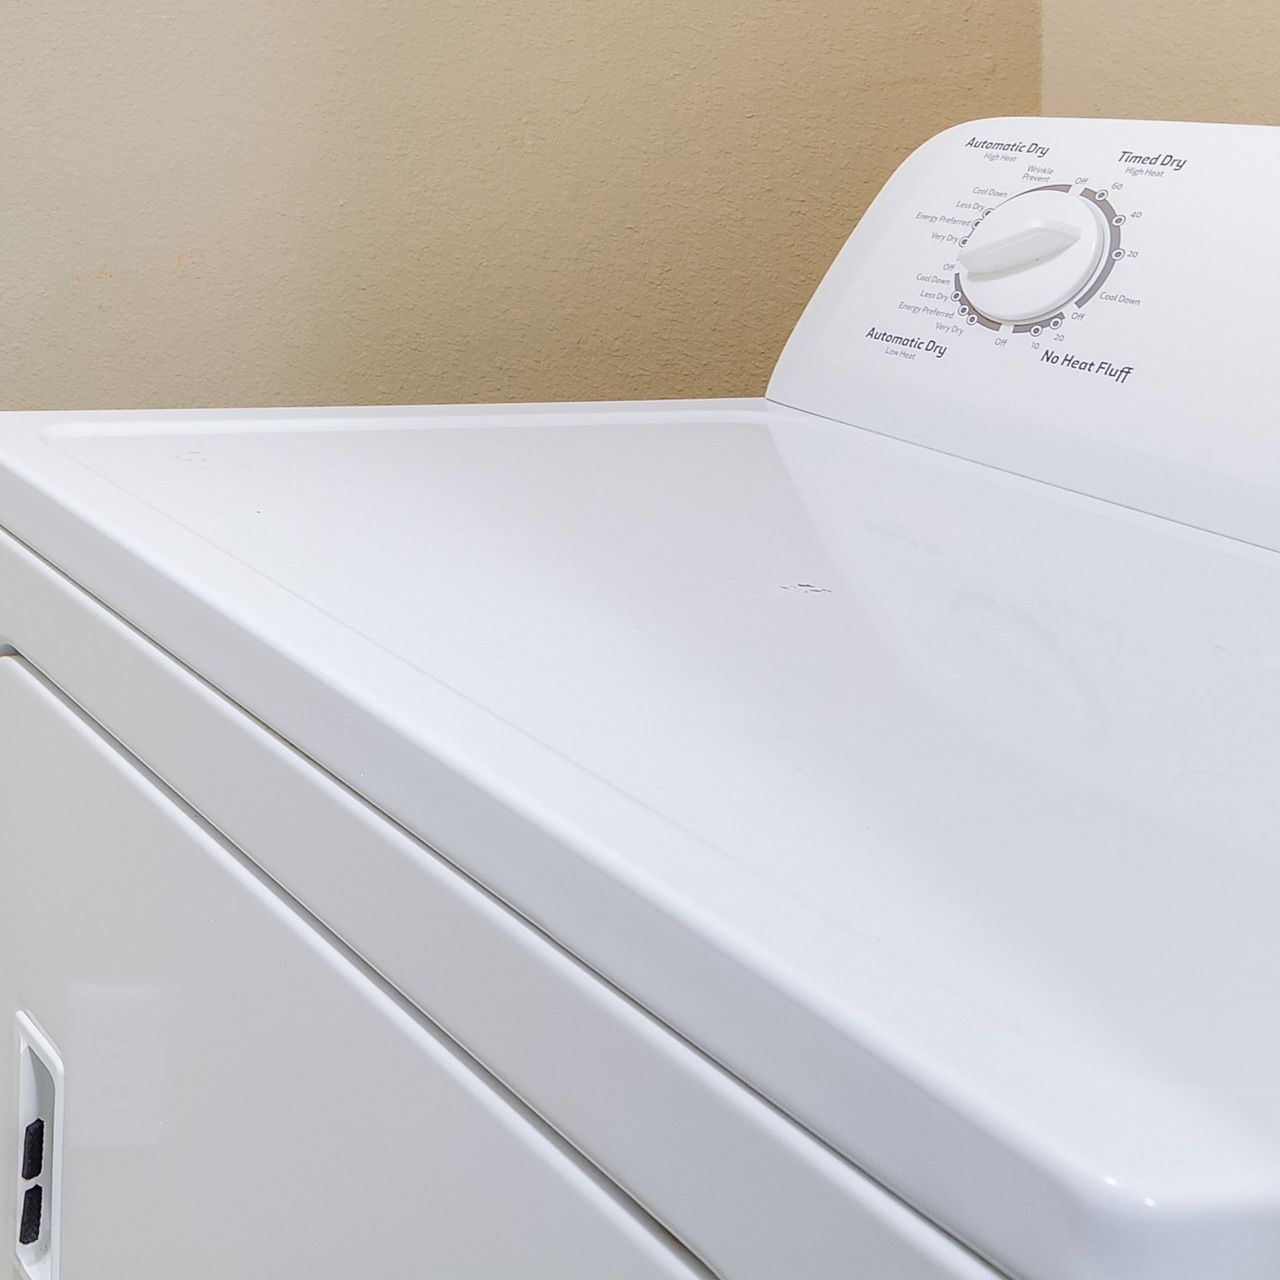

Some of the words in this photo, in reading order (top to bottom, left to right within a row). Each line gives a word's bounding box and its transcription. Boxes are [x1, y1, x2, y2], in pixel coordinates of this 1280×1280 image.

[965, 137, 1027, 152] Automatic
[1027, 143, 1050, 157] Dry
[1118, 151, 1161, 166] Timed
[1160, 154, 1187, 170] Dry
[1027, 165, 1054, 175] Wrinkle
[1125, 167, 1144, 176] High
[1144, 169, 1165, 177] Heat
[1022, 173, 1050, 183] Prevent
[1111, 182, 1123, 190] 60
[972, 187, 989, 195] Cool
[989, 188, 1008, 198] Down
[956, 200, 972, 209] Less
[972, 202, 985, 212] Dry
[915, 211, 939, 223] Energy
[939, 216, 971, 227] Preferred
[931, 231, 947, 242] Very
[946, 235, 959, 244] Dry
[1127, 250, 1139, 258] 20
[916, 273, 931, 282] Cool
[930, 275, 951, 285] Down
[920, 290, 936, 300] Less
[935, 293, 949, 303] Dry
[1099, 291, 1117, 302] Cool
[1118, 295, 1141, 306] Down
[898, 301, 922, 314] Energy
[922, 306, 955, 319] Preferred
[1071, 312, 1086, 321] Off
[935, 321, 951, 332] Very
[950, 325, 964, 336] Dry
[865, 327, 925, 350] Automatic
[924, 339, 948, 358] Dry
[994, 337, 1008, 347] Off
[1053, 333, 1065, 342] 20
[1031, 341, 1040, 350] 10
[1040, 349, 1059, 365] No
[1060, 353, 1094, 372] Heat
[1095, 361, 1134, 384] Fluff
